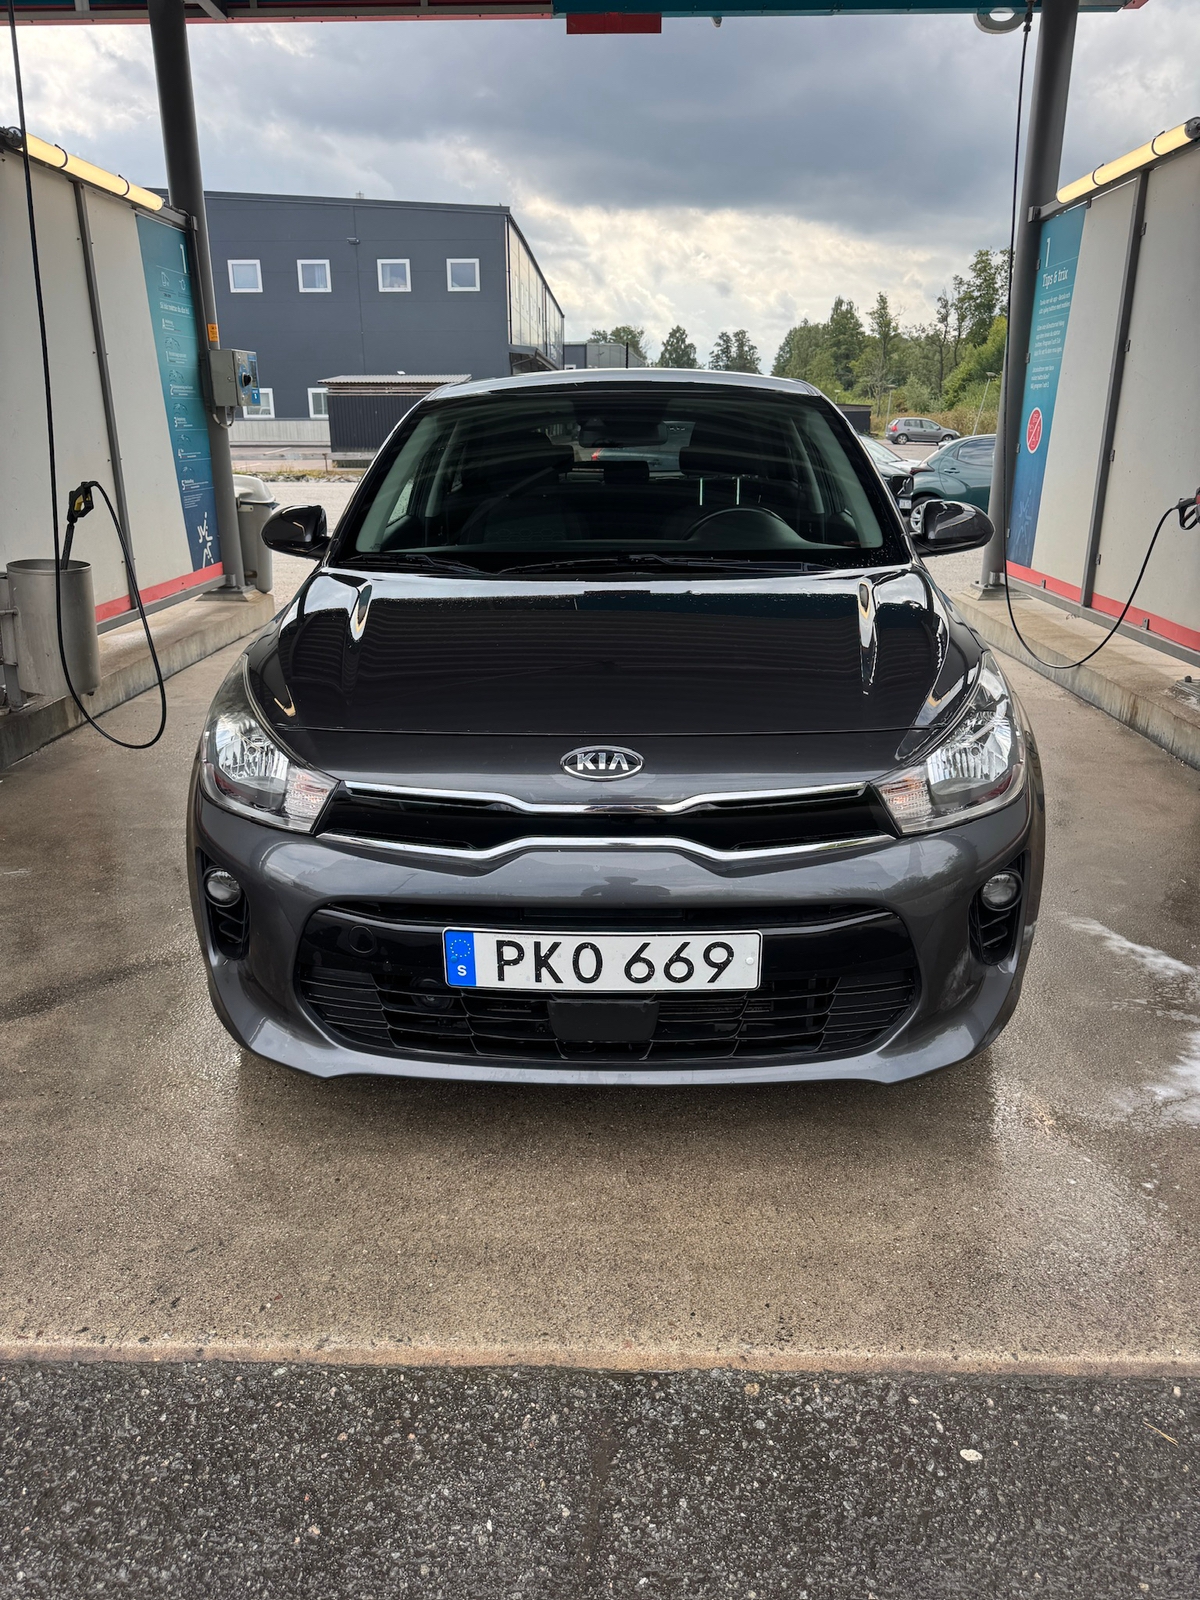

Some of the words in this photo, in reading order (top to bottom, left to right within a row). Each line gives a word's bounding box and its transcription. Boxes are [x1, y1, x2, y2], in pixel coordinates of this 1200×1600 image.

[180, 244, 187, 274] 1
[1046, 237, 1051, 268] 1
[1042, 273, 1053, 289] Tips
[1058, 267, 1069, 282] trix
[576, 752, 630, 771] KIA
[457, 965, 467, 977] S
[624, 941, 734, 984] 669
